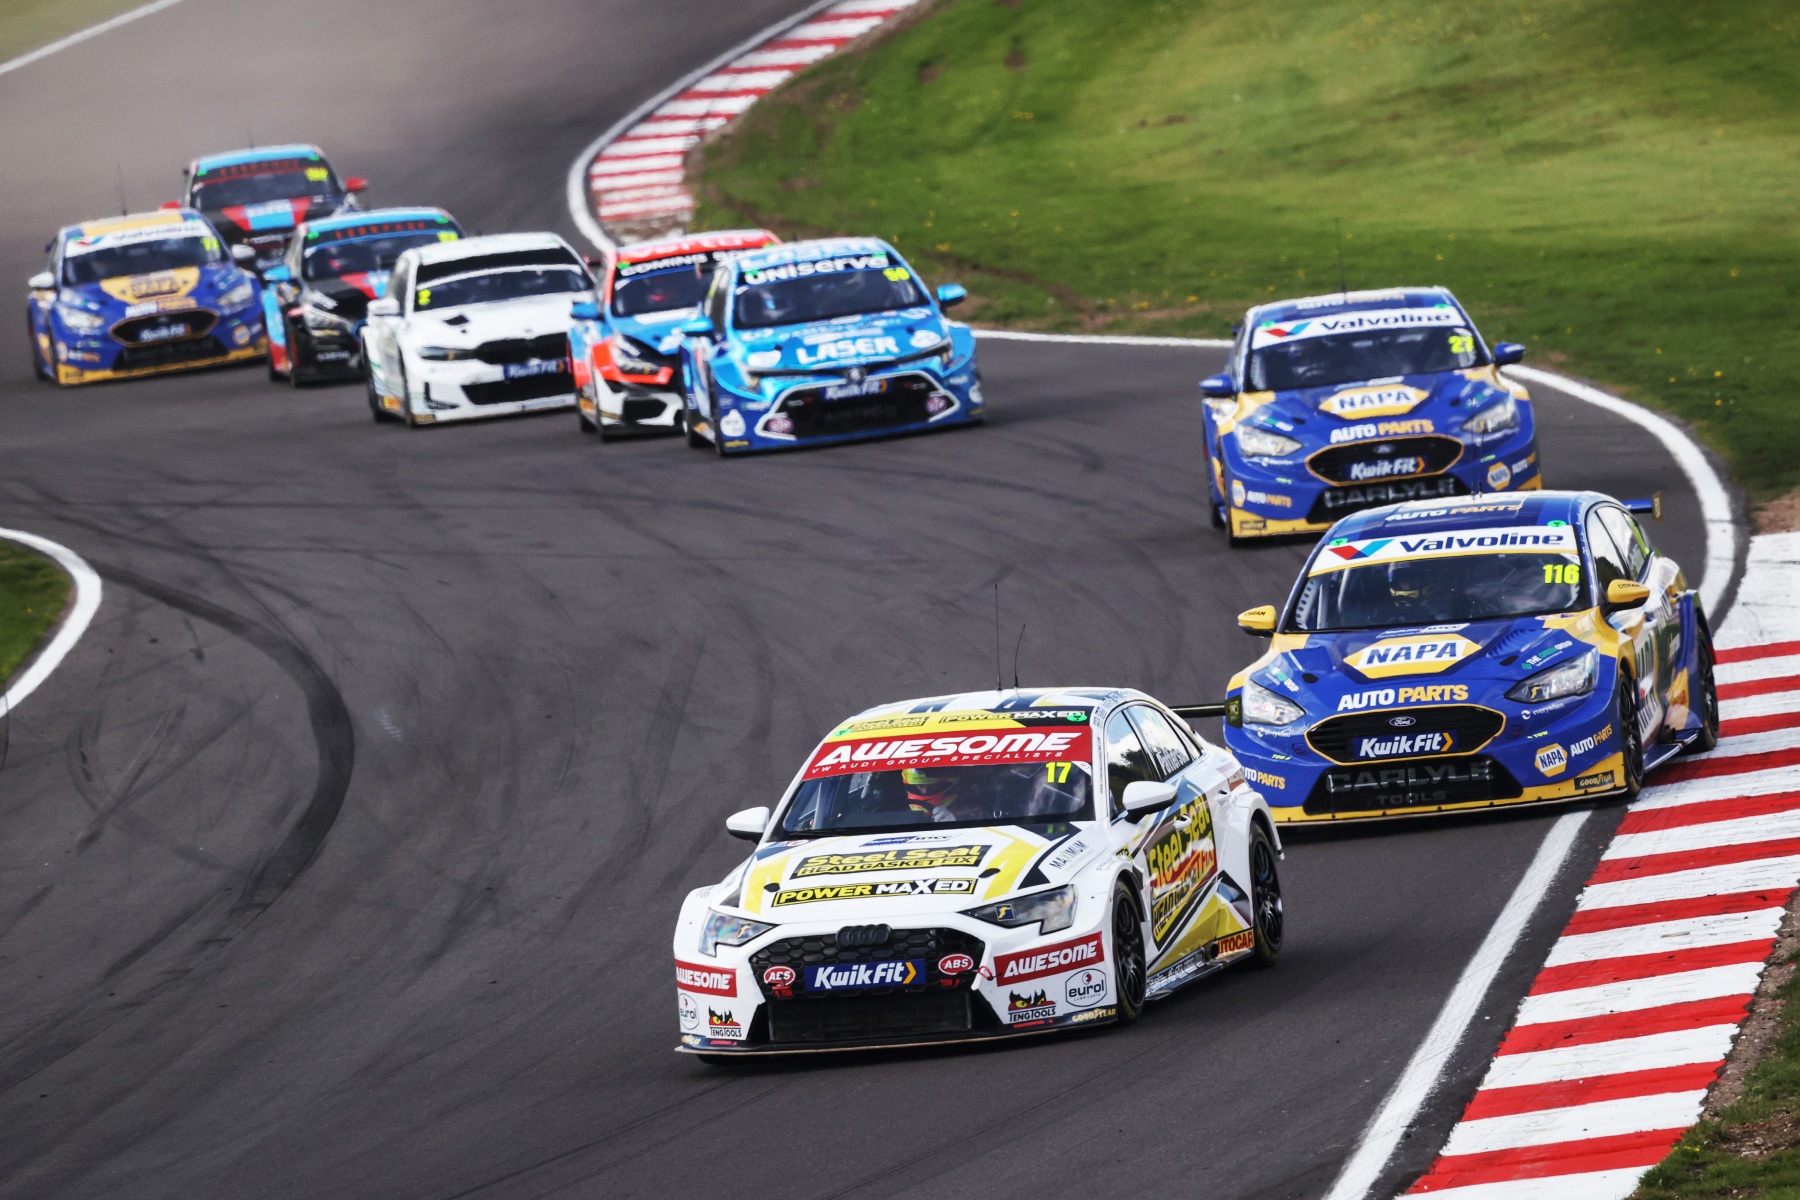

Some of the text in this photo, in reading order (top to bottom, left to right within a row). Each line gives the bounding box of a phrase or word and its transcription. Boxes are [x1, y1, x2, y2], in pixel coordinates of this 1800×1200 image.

[1321, 309, 1451, 331] Valvoline
[796, 336, 899, 364] LASER
[1448, 335, 1474, 354] 27
[1339, 391, 1411, 410] NAPA
[1330, 419, 1434, 443] AUTO PARTS
[1324, 477, 1455, 507] CARLYLE
[1386, 503, 1523, 521] AUTO PARTS
[1400, 532, 1564, 554] Valvoline
[1543, 564, 1580, 584] 116
[1367, 642, 1457, 665] NAPA
[1526, 655, 1541, 665] THE
[1337, 684, 1469, 711] AUTO PARTS
[947, 711, 1012, 722] POWER
[1533, 702, 1565, 716] everywhen
[1393, 716, 1412, 726] Ford
[814, 732, 1083, 767] AWESOME
[1570, 724, 1613, 757] AUTO PARTS
[811, 751, 1063, 774] VW AUDI GROUP SPECIALISTS
[1540, 749, 1564, 769] NAPA
[1045, 762, 1072, 784] 17
[1243, 767, 1286, 790] UTO PARTS
[1326, 760, 1494, 793] CARLYLE
[1376, 790, 1447, 806] TOOLS
[800, 855, 974, 876] HEAD GASKET FIX
[806, 845, 982, 868] Steel Seal
[1049, 839, 1090, 870] MAXIMUM
[1150, 828, 1182, 888] Steel
[779, 879, 970, 904] POWER MAXED
[1217, 929, 1254, 955] UTOCAR
[943, 958, 970, 970] ABS
[1003, 940, 1098, 978] AWESOME
[1068, 979, 1105, 998] eurol
[1072, 1007, 1117, 1023] GOODYEAR
